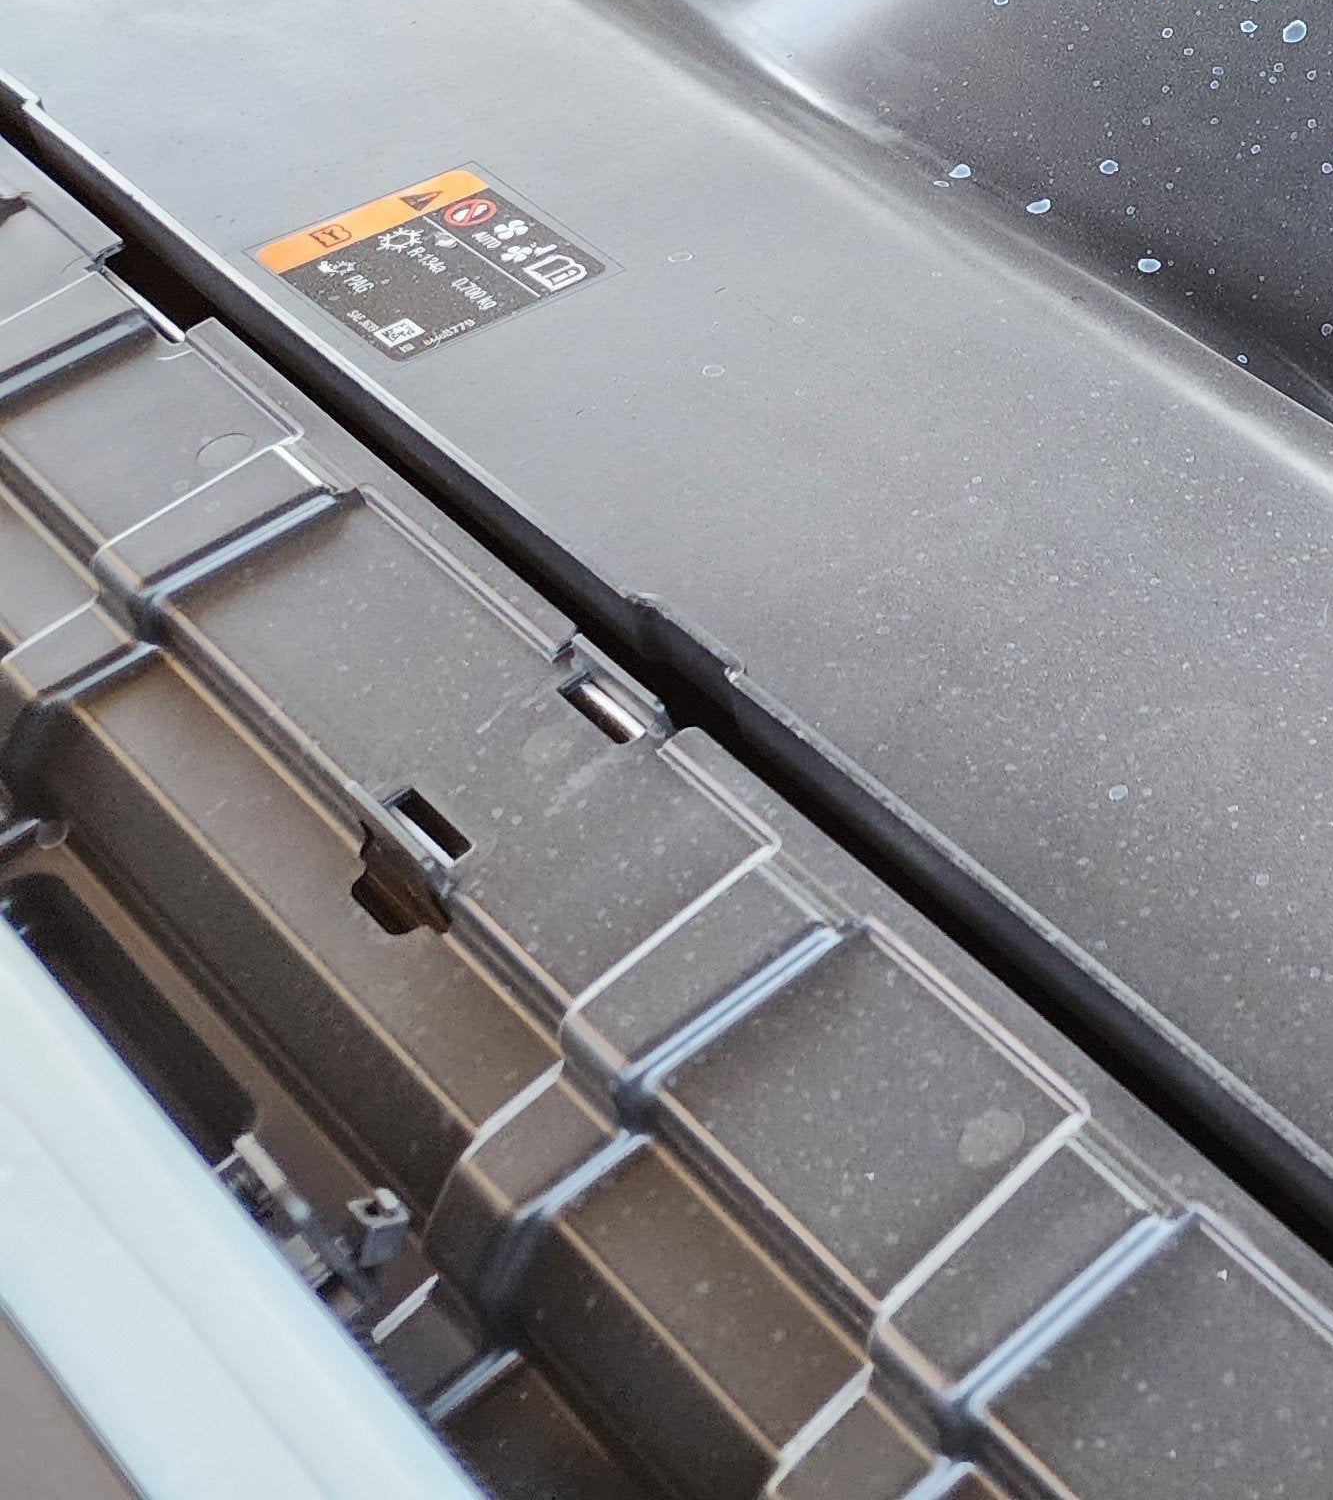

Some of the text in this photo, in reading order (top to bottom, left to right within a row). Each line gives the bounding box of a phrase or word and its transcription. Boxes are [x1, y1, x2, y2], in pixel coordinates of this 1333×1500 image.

[471, 231, 503, 250] AUTO
[406, 245, 448, 275] R-134a
[341, 271, 375, 295] PAG
